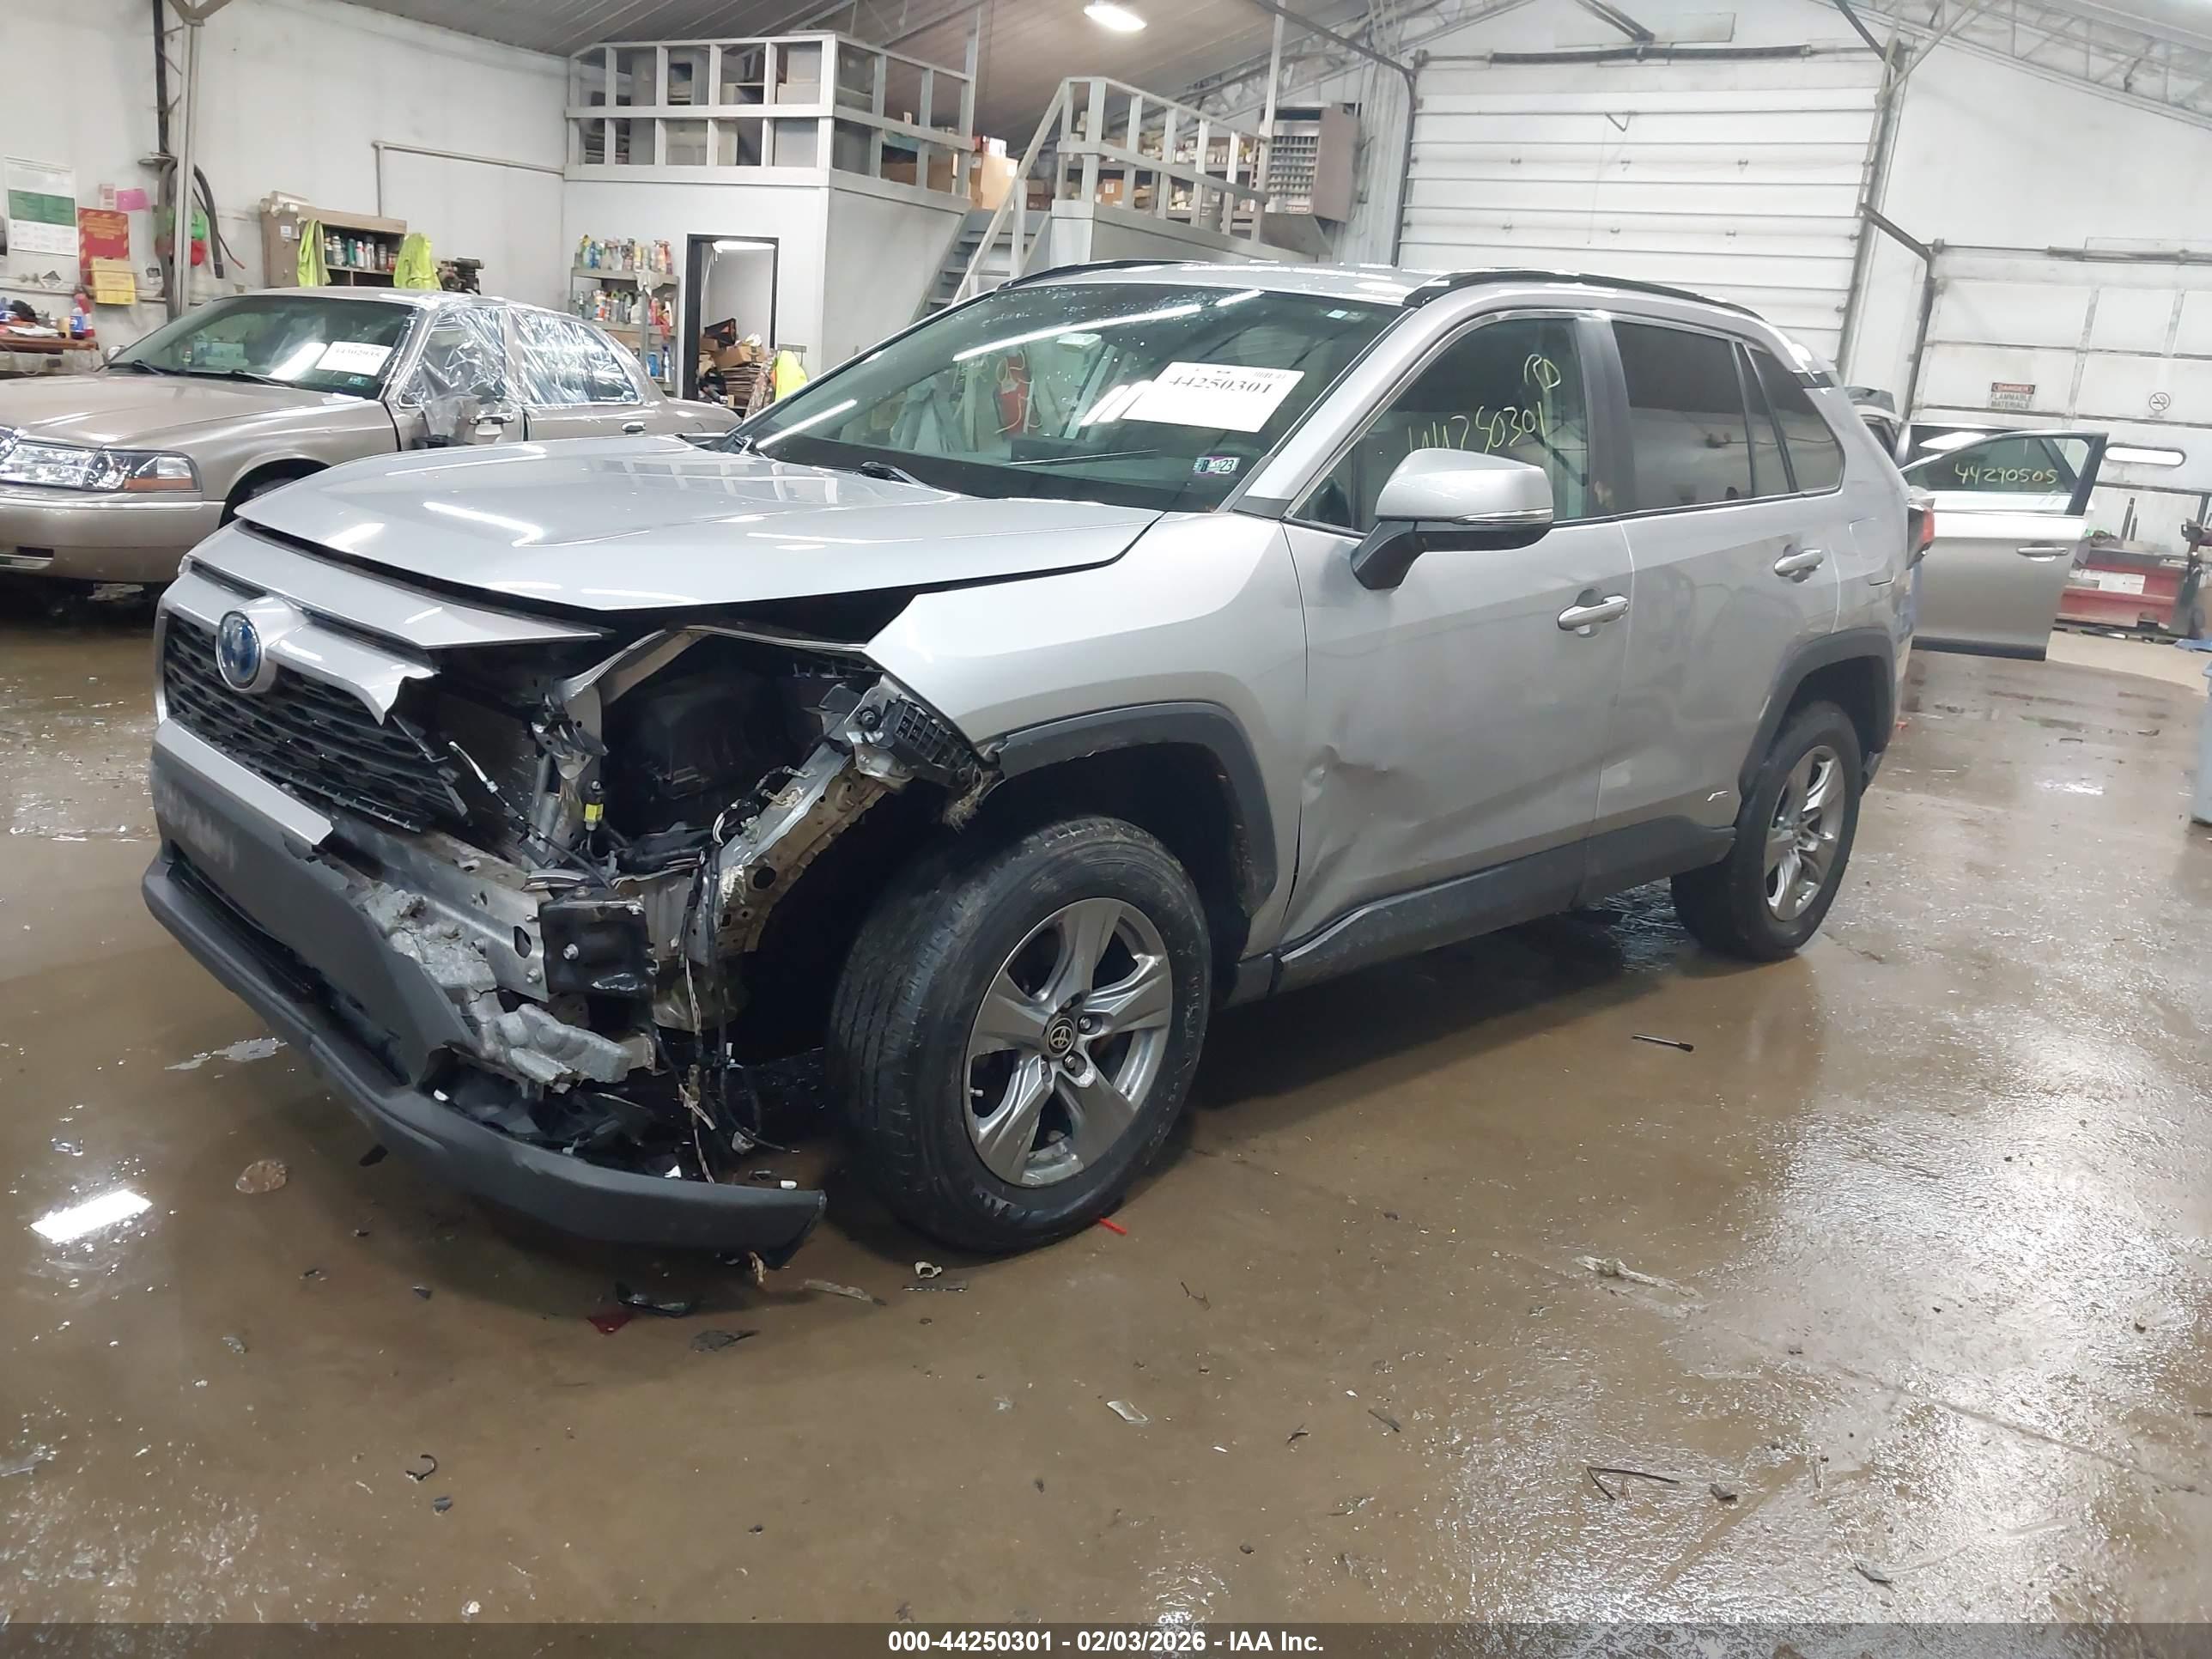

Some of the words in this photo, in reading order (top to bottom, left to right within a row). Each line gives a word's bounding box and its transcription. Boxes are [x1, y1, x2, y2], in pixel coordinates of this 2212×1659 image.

[1169, 375, 1273, 393] 44250301
[1990, 392, 2033, 402] FLAMMABLE
[1990, 401, 2029, 410] MATERIALS
[1955, 462, 2059, 486] 44290505
